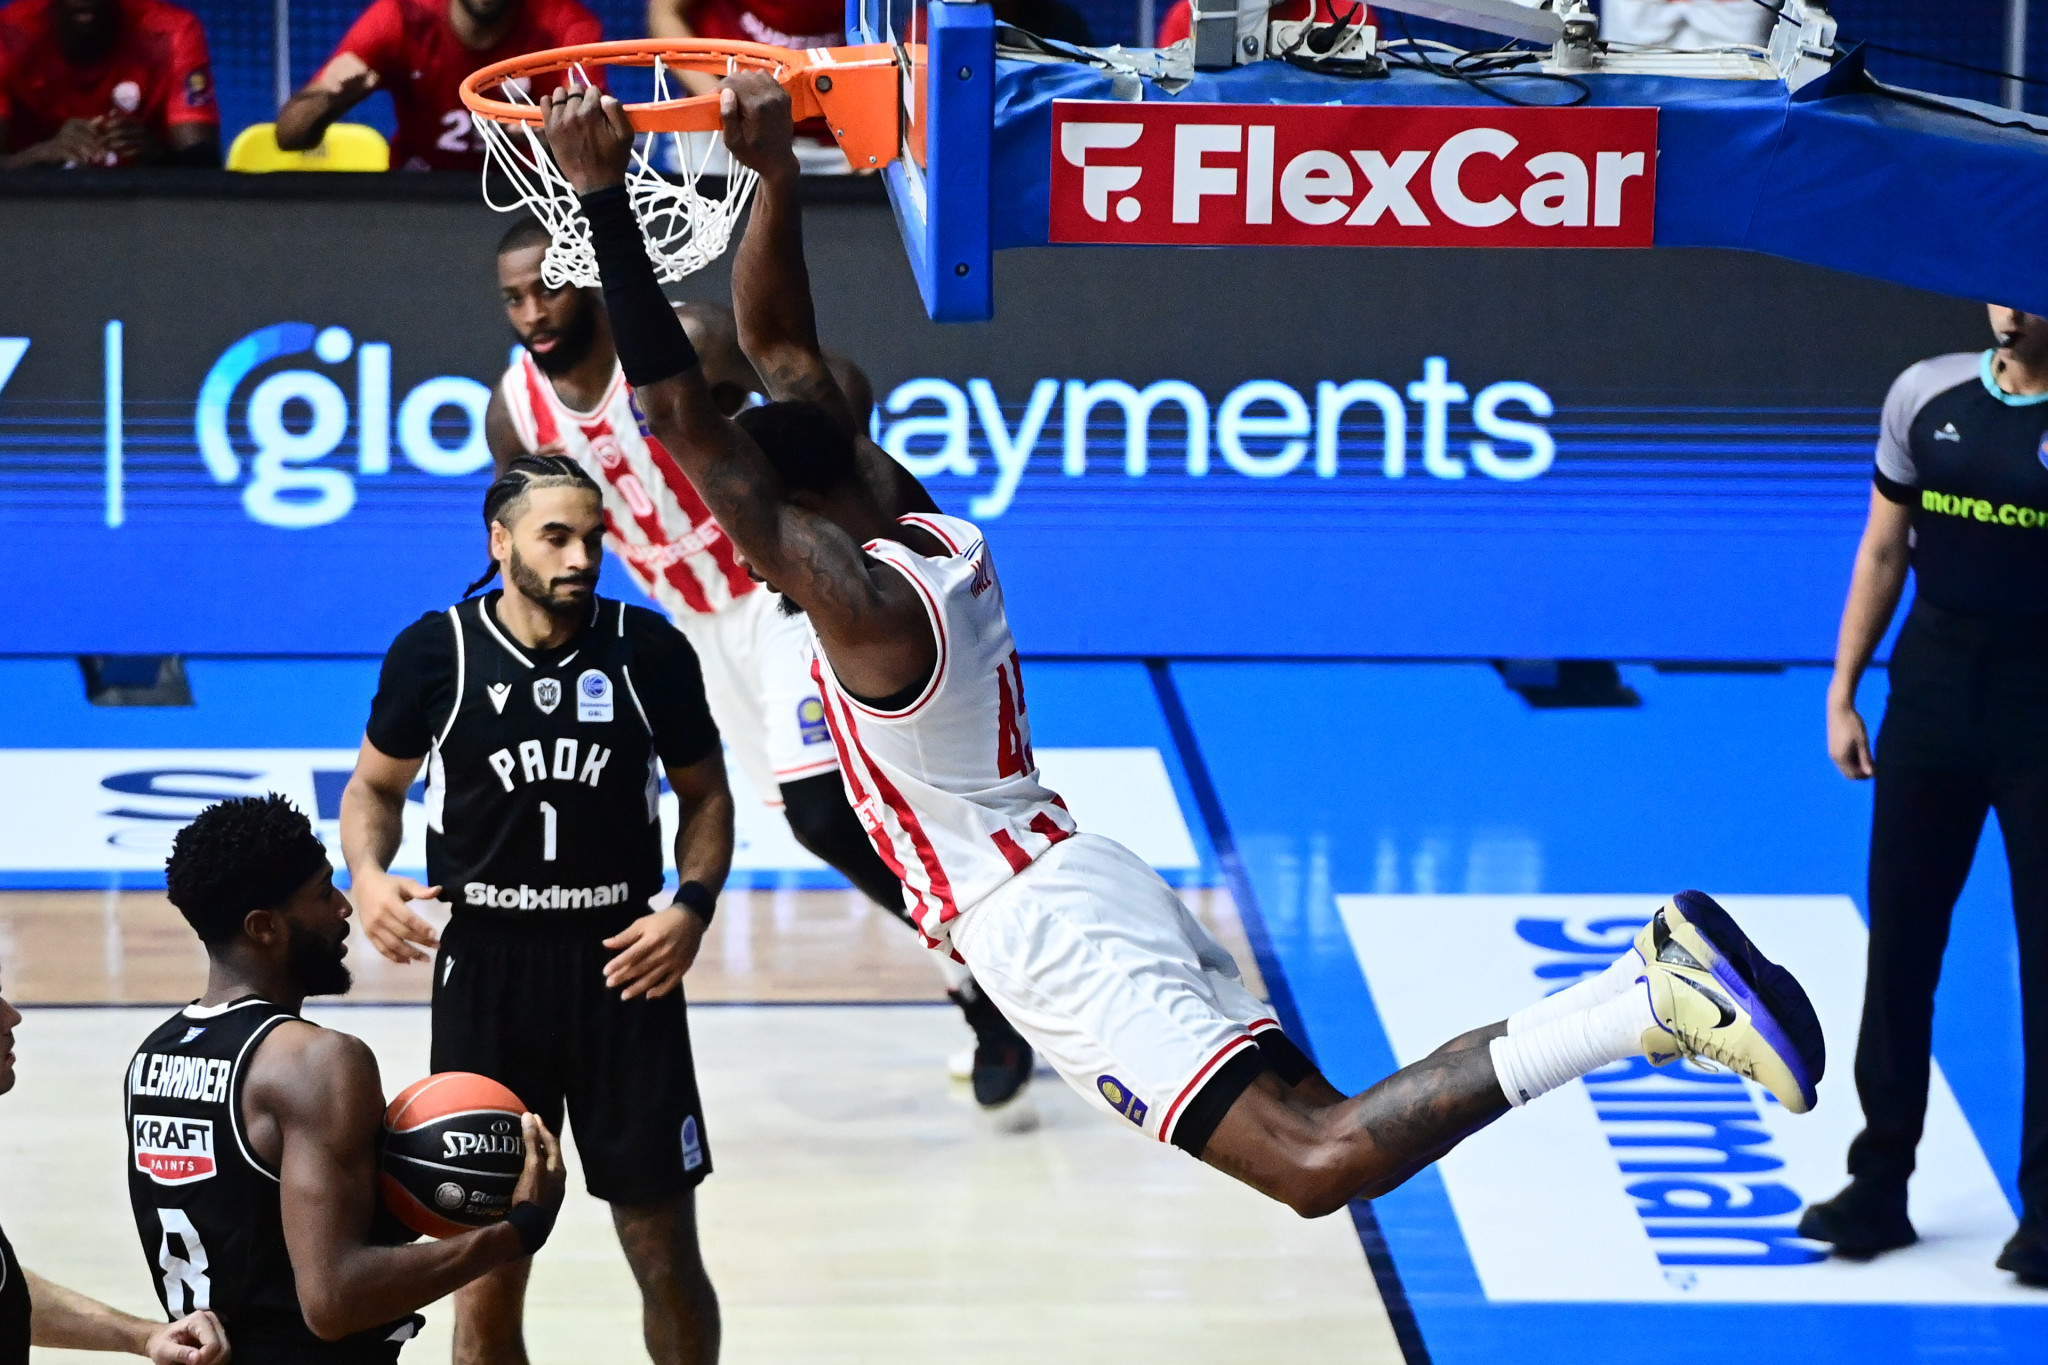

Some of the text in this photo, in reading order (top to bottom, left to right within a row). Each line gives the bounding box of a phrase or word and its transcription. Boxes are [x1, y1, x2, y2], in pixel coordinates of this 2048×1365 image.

[1173, 124, 1645, 228] FlexCar
[868, 356, 1556, 519] ayments
[488, 737, 612, 793] PAOK
[539, 800, 557, 861] 1
[464, 881, 629, 910] Stoiximan
[136, 1119, 210, 1151] KRAFT
[443, 1131, 526, 1158] SPALDI
